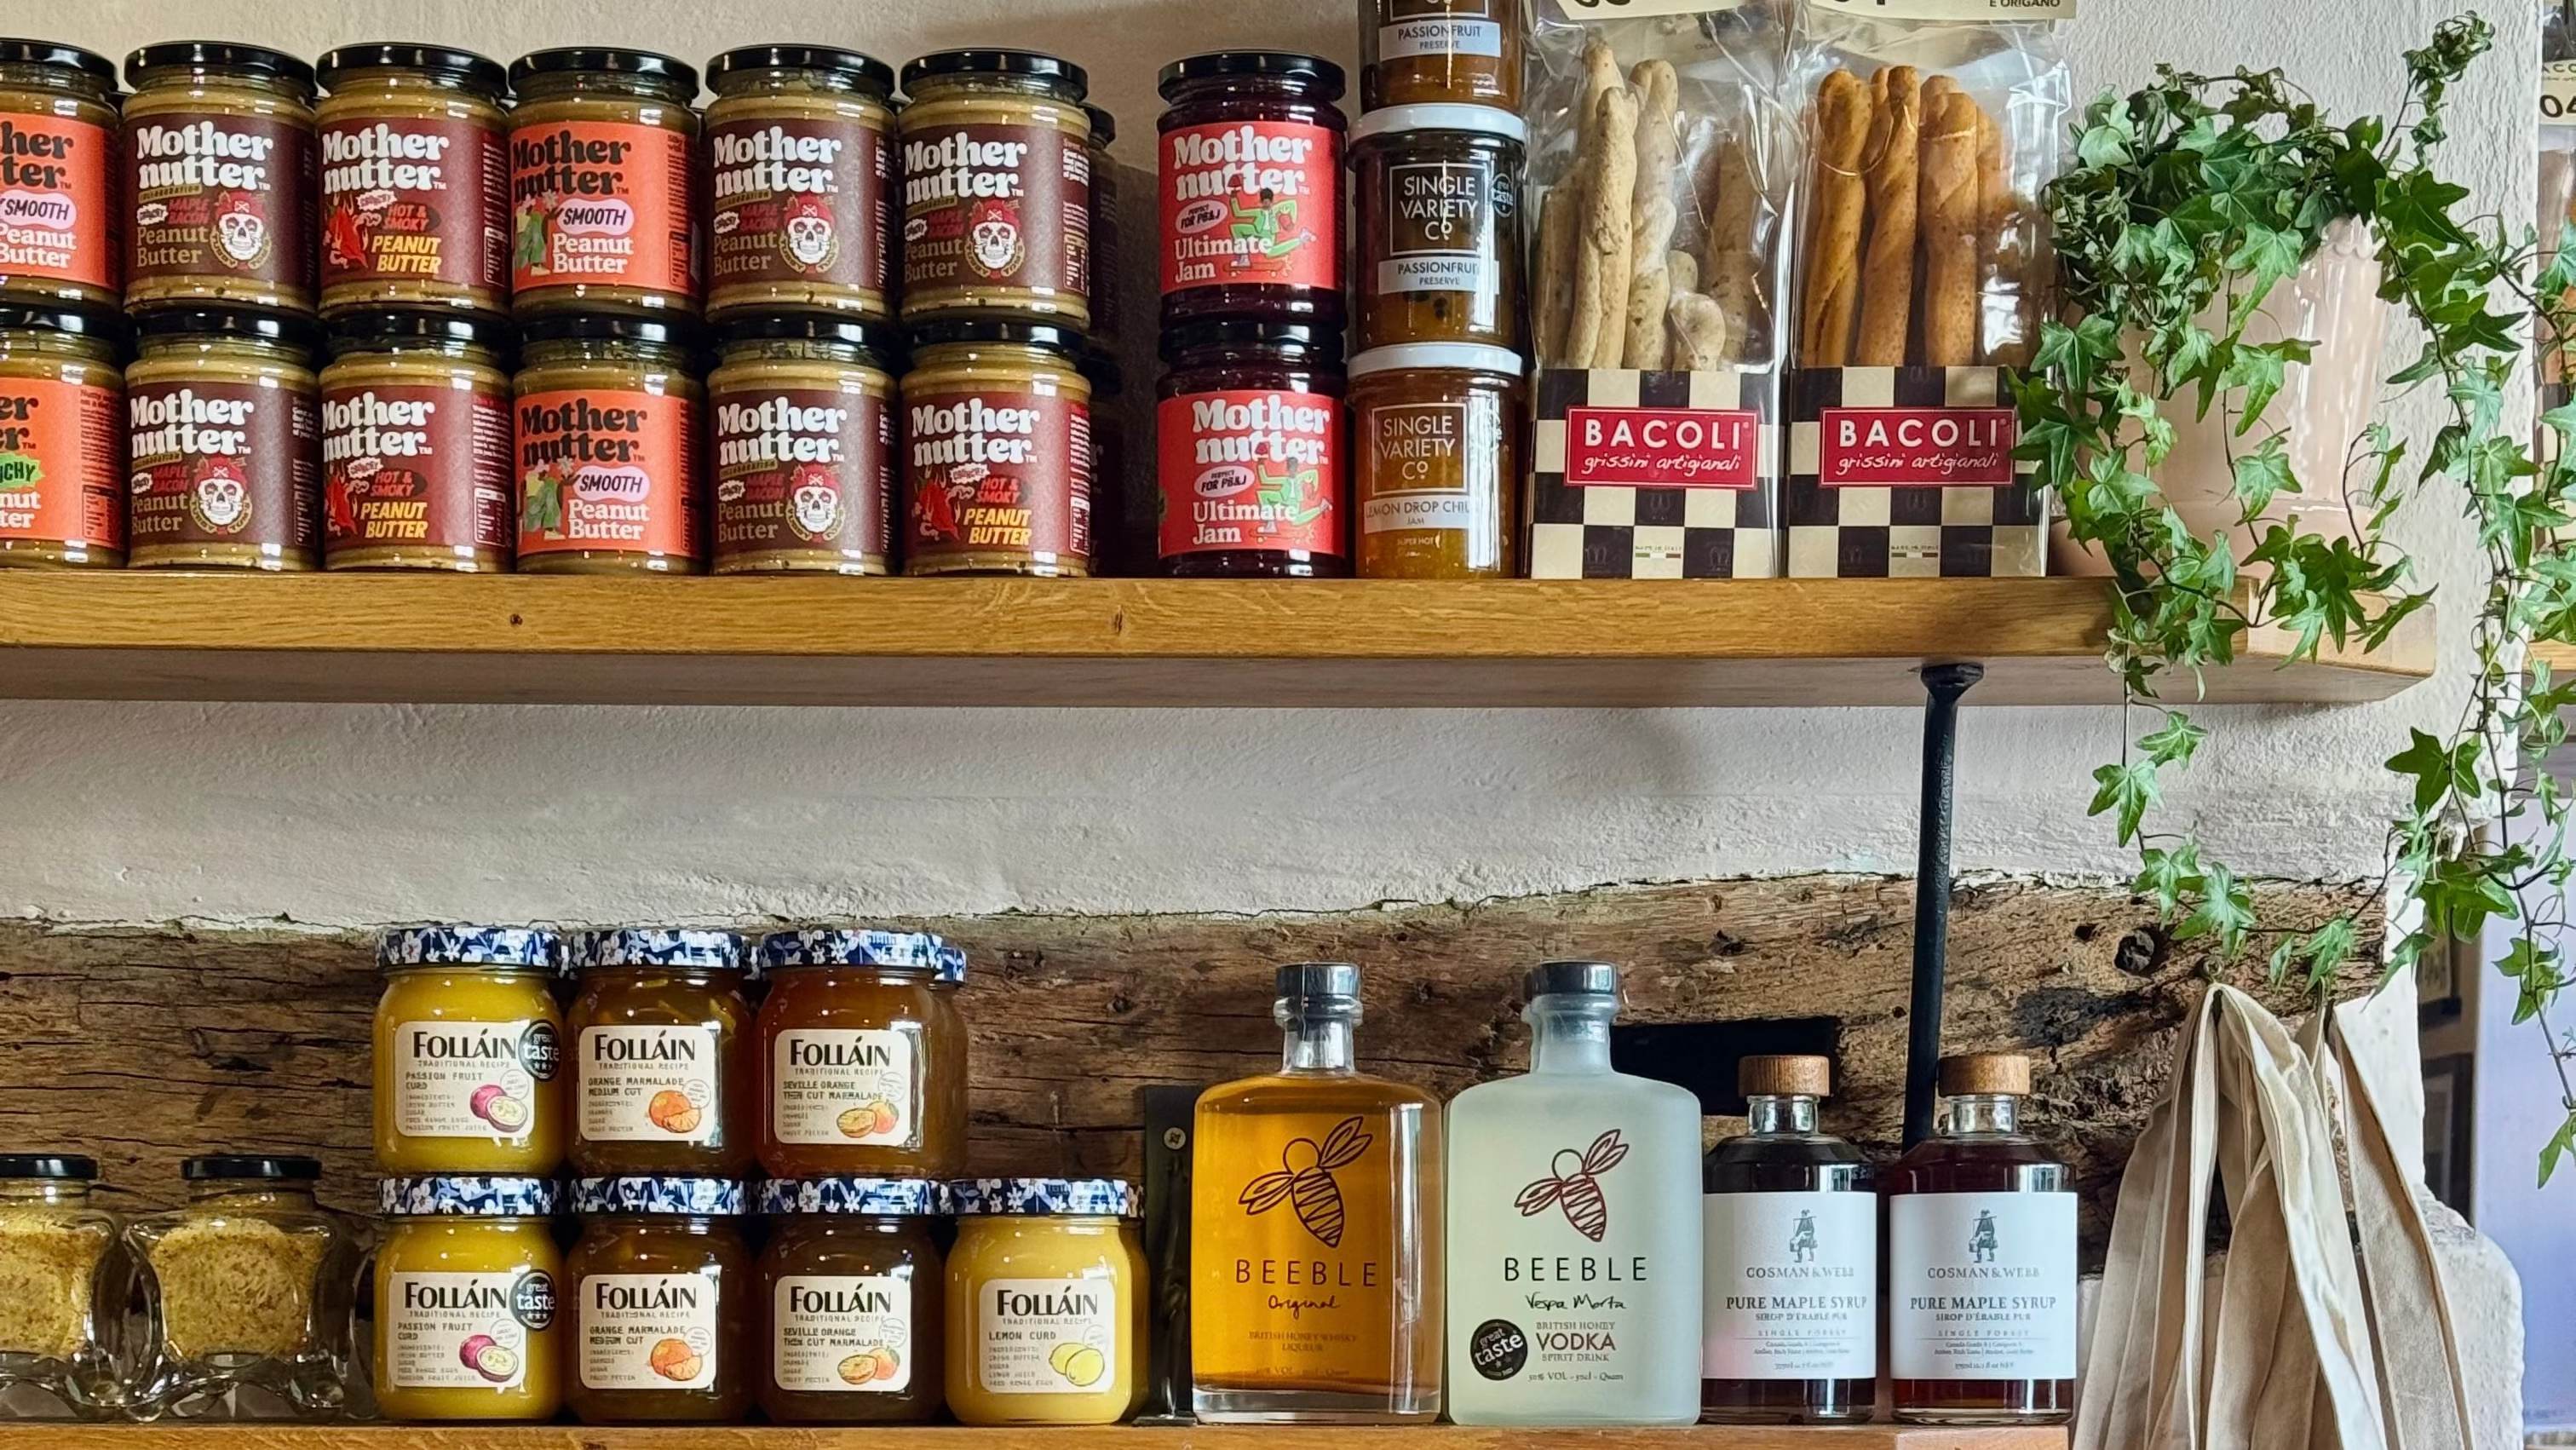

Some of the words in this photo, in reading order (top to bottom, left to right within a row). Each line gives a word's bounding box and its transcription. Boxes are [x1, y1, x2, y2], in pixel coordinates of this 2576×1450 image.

[137, 121, 273, 161] Mother
[323, 124, 449, 164] Mother
[513, 129, 631, 173] Mother
[714, 126, 842, 168] Mother
[1173, 125, 1313, 169] Mother
[905, 131, 1027, 175] Mother
[1404, 176, 1475, 196] SINGLE
[5, 199, 70, 220] SMOOTH
[389, 206, 413, 218] HOT
[415, 205, 426, 217] &
[563, 209, 626, 226] SMOOTH
[1400, 199, 1479, 218] VARIETY
[384, 218, 429, 231] SMOKY
[137, 226, 209, 245] Peanut
[372, 235, 441, 254] PEANUT
[552, 233, 634, 255] Peanut
[714, 232, 777, 255] Peanut
[137, 248, 202, 267] Butter
[905, 239, 963, 262] Peanut
[1174, 236, 1274, 261] Ultimate
[377, 255, 442, 273] BUTTER
[553, 253, 628, 273] Butter
[714, 255, 772, 276] Butter
[905, 261, 957, 284] Butter
[1175, 260, 1216, 283] Jam
[130, 388, 254, 429] Mother
[322, 391, 435, 434] Mother
[521, 398, 647, 437] Mother
[718, 396, 848, 436] Mother
[911, 398, 1040, 437] Mother
[1193, 394, 1330, 434] Mother
[1383, 416, 1453, 437] SINGLE
[1584, 419, 1740, 451] BACOLI
[1839, 419, 1997, 447] BACOLI
[1380, 438, 1456, 459] VARIETY
[1581, 452, 1651, 475] grissini
[1656, 454, 1741, 477] artigianali
[1835, 452, 1905, 475] grissini
[1912, 452, 1999, 475] artigianali
[376, 471, 400, 483] HOT
[402, 471, 412, 483] &
[580, 475, 642, 493] SMOOTH
[981, 479, 1005, 491] HOT
[1009, 480, 1020, 491] &
[1201, 480, 1218, 492] FOR
[370, 484, 414, 497] SMOKY
[977, 491, 1021, 503] SMOKY
[131, 493, 187, 514] Peanut
[359, 501, 428, 520] PEANUT
[568, 499, 650, 521] Peanut
[718, 501, 785, 522] Peanut
[1193, 500, 1297, 522] Ultimate
[1365, 503, 1400, 518] LEMON
[1404, 501, 1440, 514] DROP
[131, 515, 182, 536] Butter
[963, 509, 1032, 526] PEANUT
[365, 521, 428, 538] BUTTER
[568, 520, 644, 540] Butter
[718, 522, 779, 543] Butter
[969, 527, 1032, 545] BUTTER
[1193, 523, 1241, 544] Jam
[523, 1044, 560, 1062] taste
[588, 1077, 622, 1085] ORANGE
[626, 1077, 684, 1085] MARMALADE
[820, 1081, 855, 1090] ORANGE
[807, 1091, 824, 1100] CUT
[828, 1091, 883, 1100] MARMALADE
[1235, 1259, 1377, 1286] BEEBLE
[1504, 1257, 1647, 1281] BEEBLE
[1746, 1267, 1808, 1278] COSMAN
[1928, 1267, 1989, 1278] COSMAN
[526, 1282, 549, 1294] great
[516, 1294, 555, 1310] taste
[1268, 1294, 1340, 1321] Original
[1525, 1292, 1568, 1311] Vespa
[1573, 1292, 1627, 1309] Morta
[1726, 1296, 1767, 1309] PURE
[1772, 1296, 1826, 1309] MAPLE
[1830, 1296, 1867, 1309] SYRUP
[1910, 1296, 1946, 1309] PURE
[1951, 1296, 2007, 1309] MAPLE
[2011, 1296, 2056, 1309] SYRUP
[398, 1322, 436, 1331] PASSION
[589, 1326, 624, 1334] ORANGE
[628, 1326, 687, 1334] MARMALADE
[784, 1327, 819, 1336] SEVILLE
[821, 1327, 856, 1336] ORANGE
[1536, 1321, 1577, 1330] BRITISH
[988, 1332, 1022, 1340] LEMON
[1029, 1332, 1056, 1340] CURD
[1480, 1328, 1505, 1349] great
[1536, 1332, 1616, 1351] VODKA
[1475, 1334, 1524, 1366] taste
[1577, 1353, 1610, 1361] DRINK
[1547, 1372, 1567, 1380] VOL
